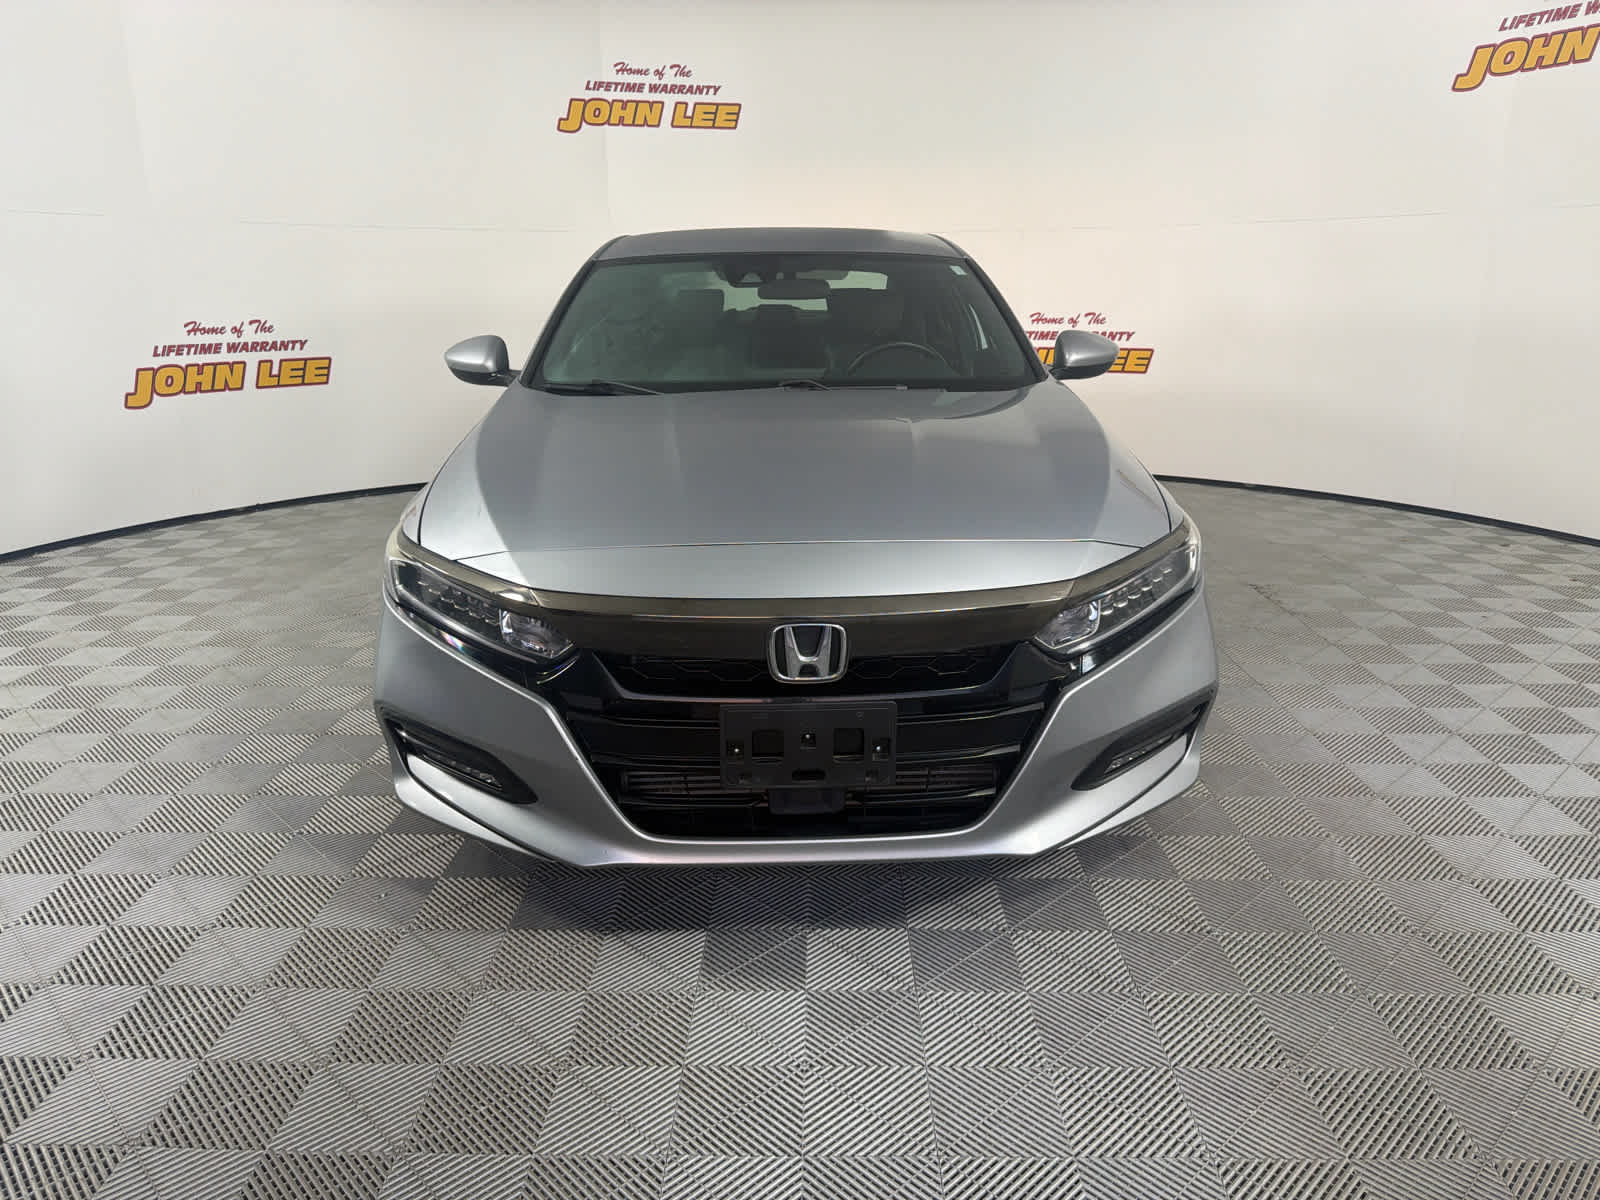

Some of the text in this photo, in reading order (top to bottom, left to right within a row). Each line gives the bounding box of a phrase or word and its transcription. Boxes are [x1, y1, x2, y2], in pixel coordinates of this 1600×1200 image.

[1498, 2, 1583, 32] LIFETIME
[1451, 23, 1600, 92] JOHN
[613, 61, 693, 80] Home of The
[585, 80, 722, 96] LIFETIME WARRANTY
[557, 97, 742, 133] JOHN LEE
[183, 319, 274, 338] Home of The
[1029, 312, 1106, 328] Home of The
[1025, 330, 1059, 341] TIME
[152, 339, 308, 358] LIFETIME WARRANTY
[1106, 347, 1155, 374] EE
[124, 356, 332, 410] JOHN LEE
